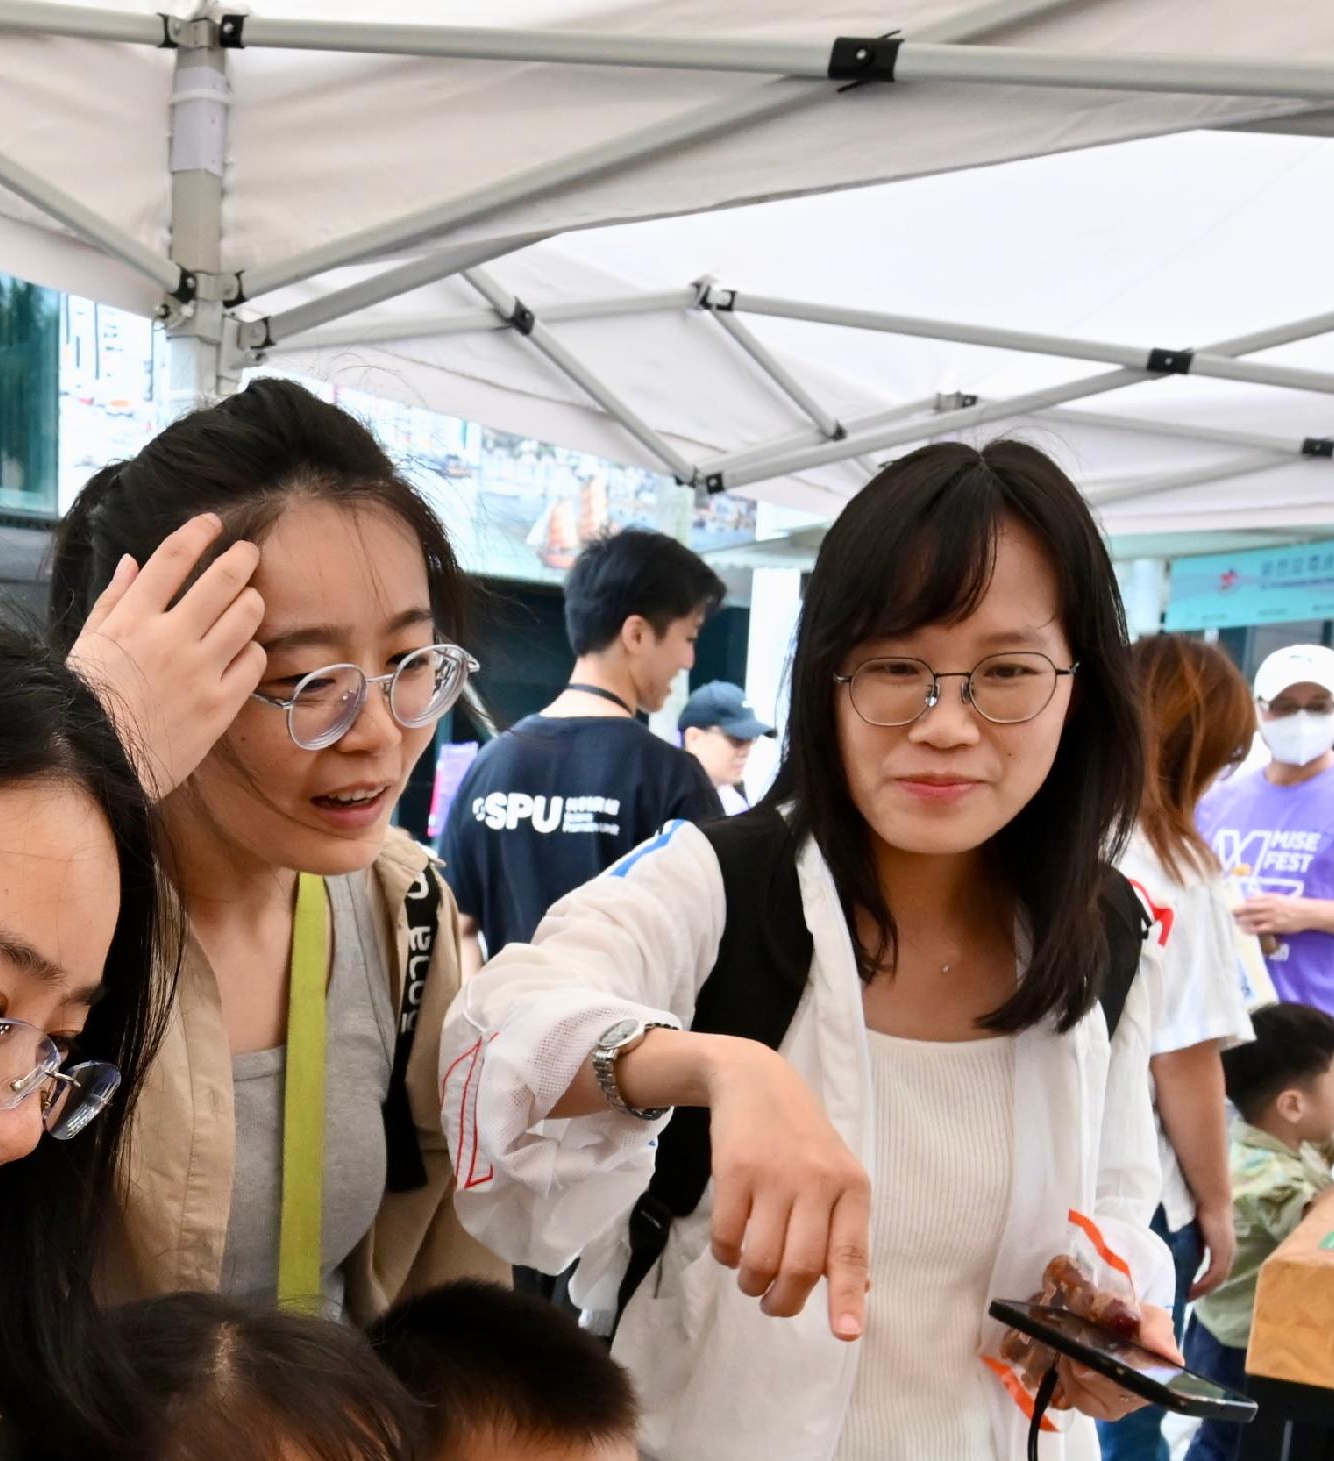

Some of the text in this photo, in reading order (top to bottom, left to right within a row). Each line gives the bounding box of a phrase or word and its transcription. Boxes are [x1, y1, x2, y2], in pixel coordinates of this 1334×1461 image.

[485, 791, 564, 834] SPU
[1269, 829, 1322, 852] MUSE
[1262, 850, 1315, 873] FEST
